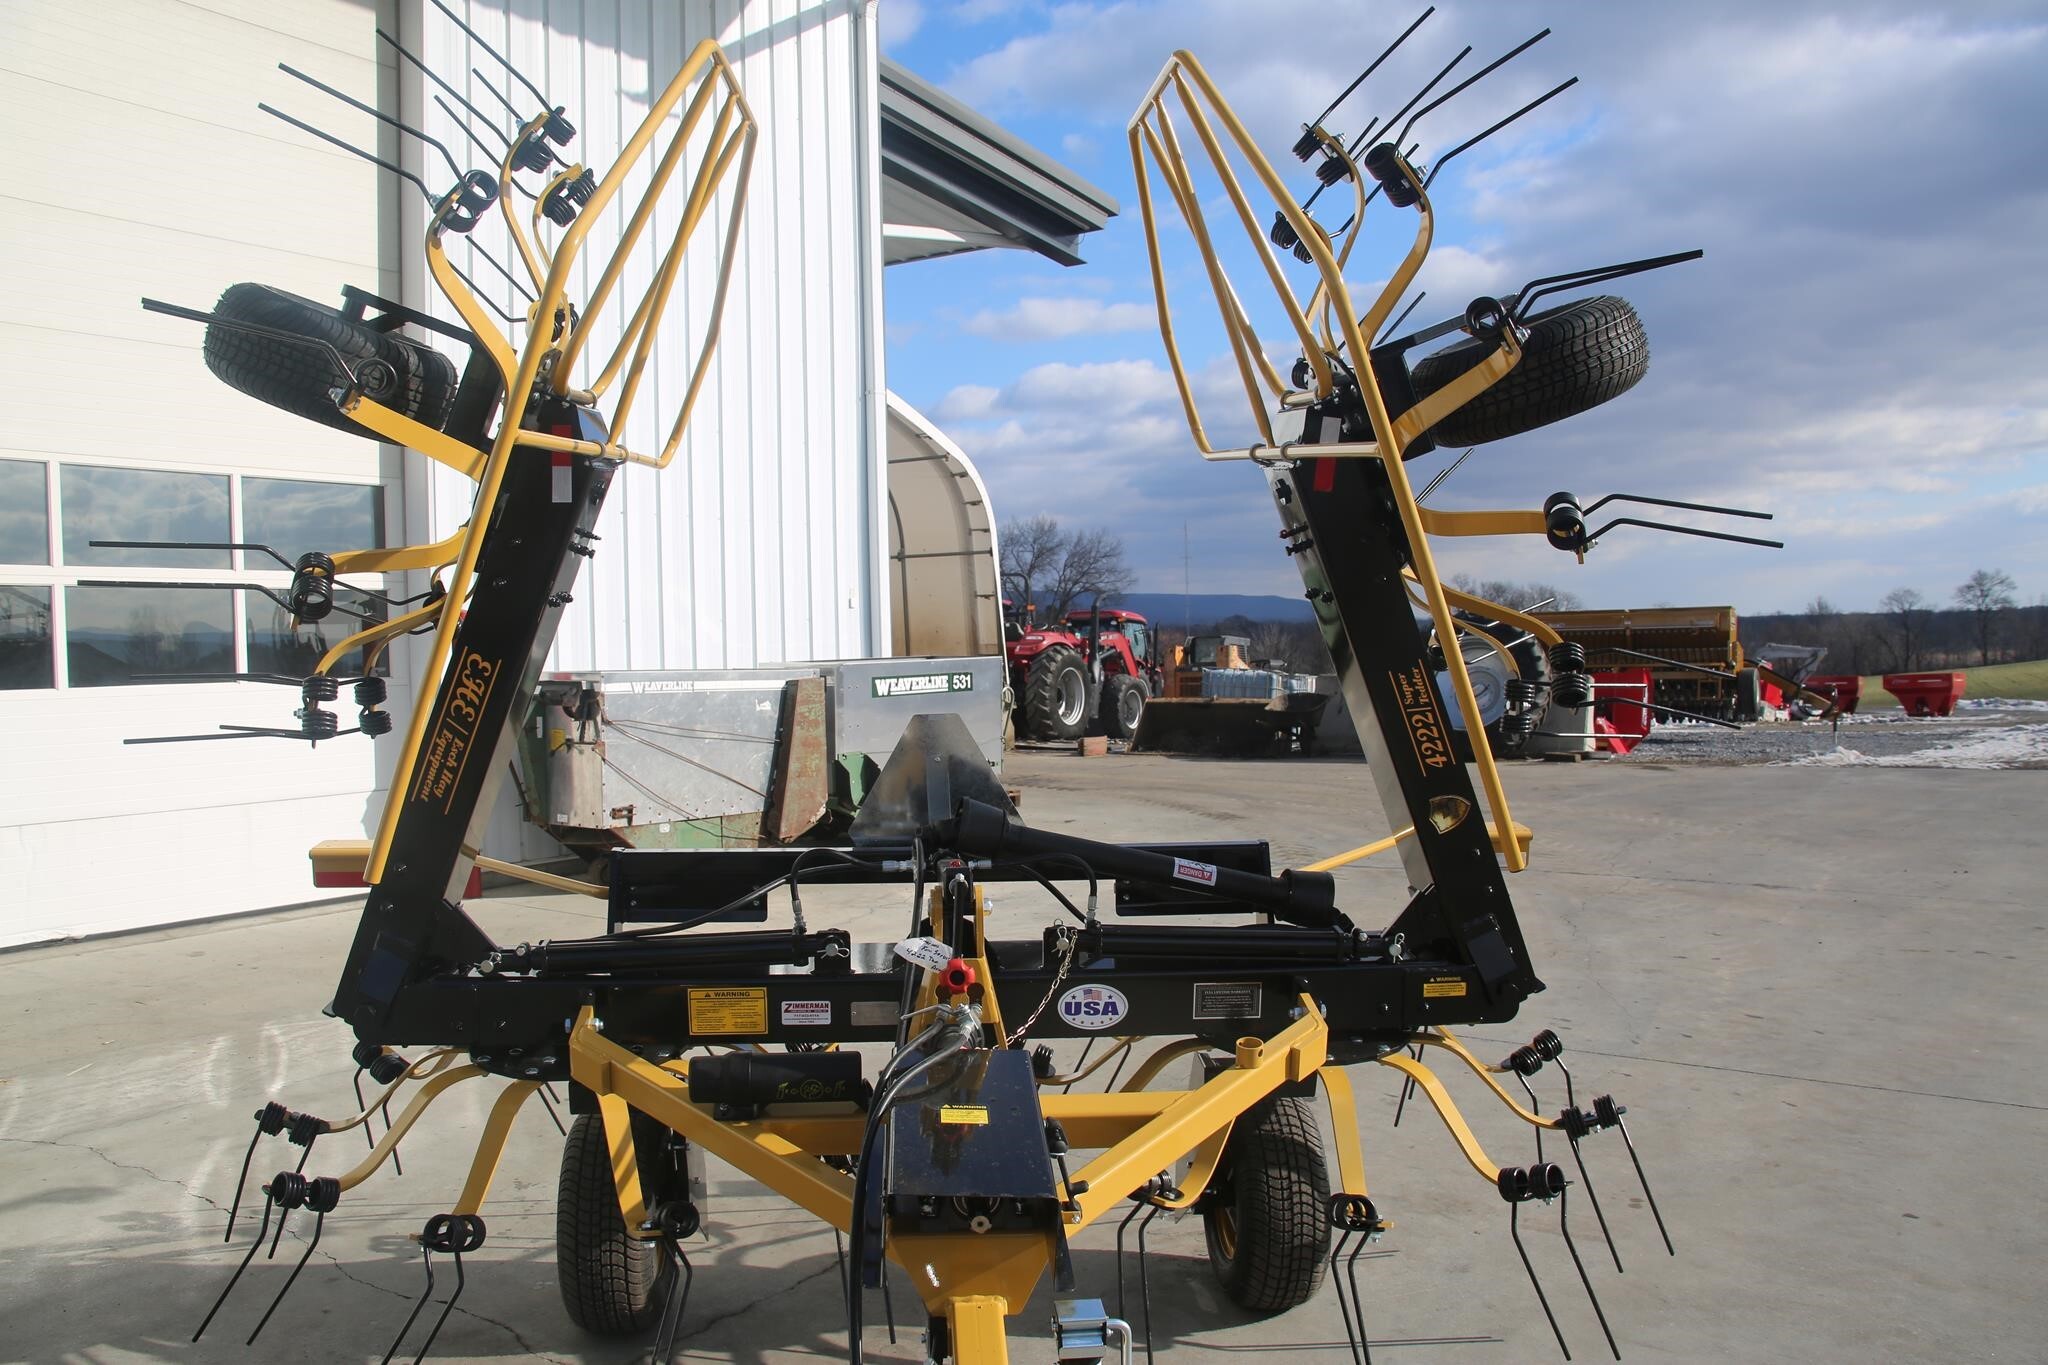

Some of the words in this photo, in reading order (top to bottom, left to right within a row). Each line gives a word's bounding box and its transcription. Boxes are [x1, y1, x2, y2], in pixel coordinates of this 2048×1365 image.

[874, 675, 949, 696] WEAVERLINE
[952, 674, 971, 689] 531
[1398, 672, 1415, 705] Super
[1411, 666, 1429, 705] Tedder
[445, 736, 465, 768] Esch
[1411, 711, 1447, 768] 4222
[420, 727, 454, 802] Equipment
[433, 769, 454, 798] Hay
[784, 1003, 829, 1013] ZIMMERMAN
[1064, 1001, 1120, 1016] USA
